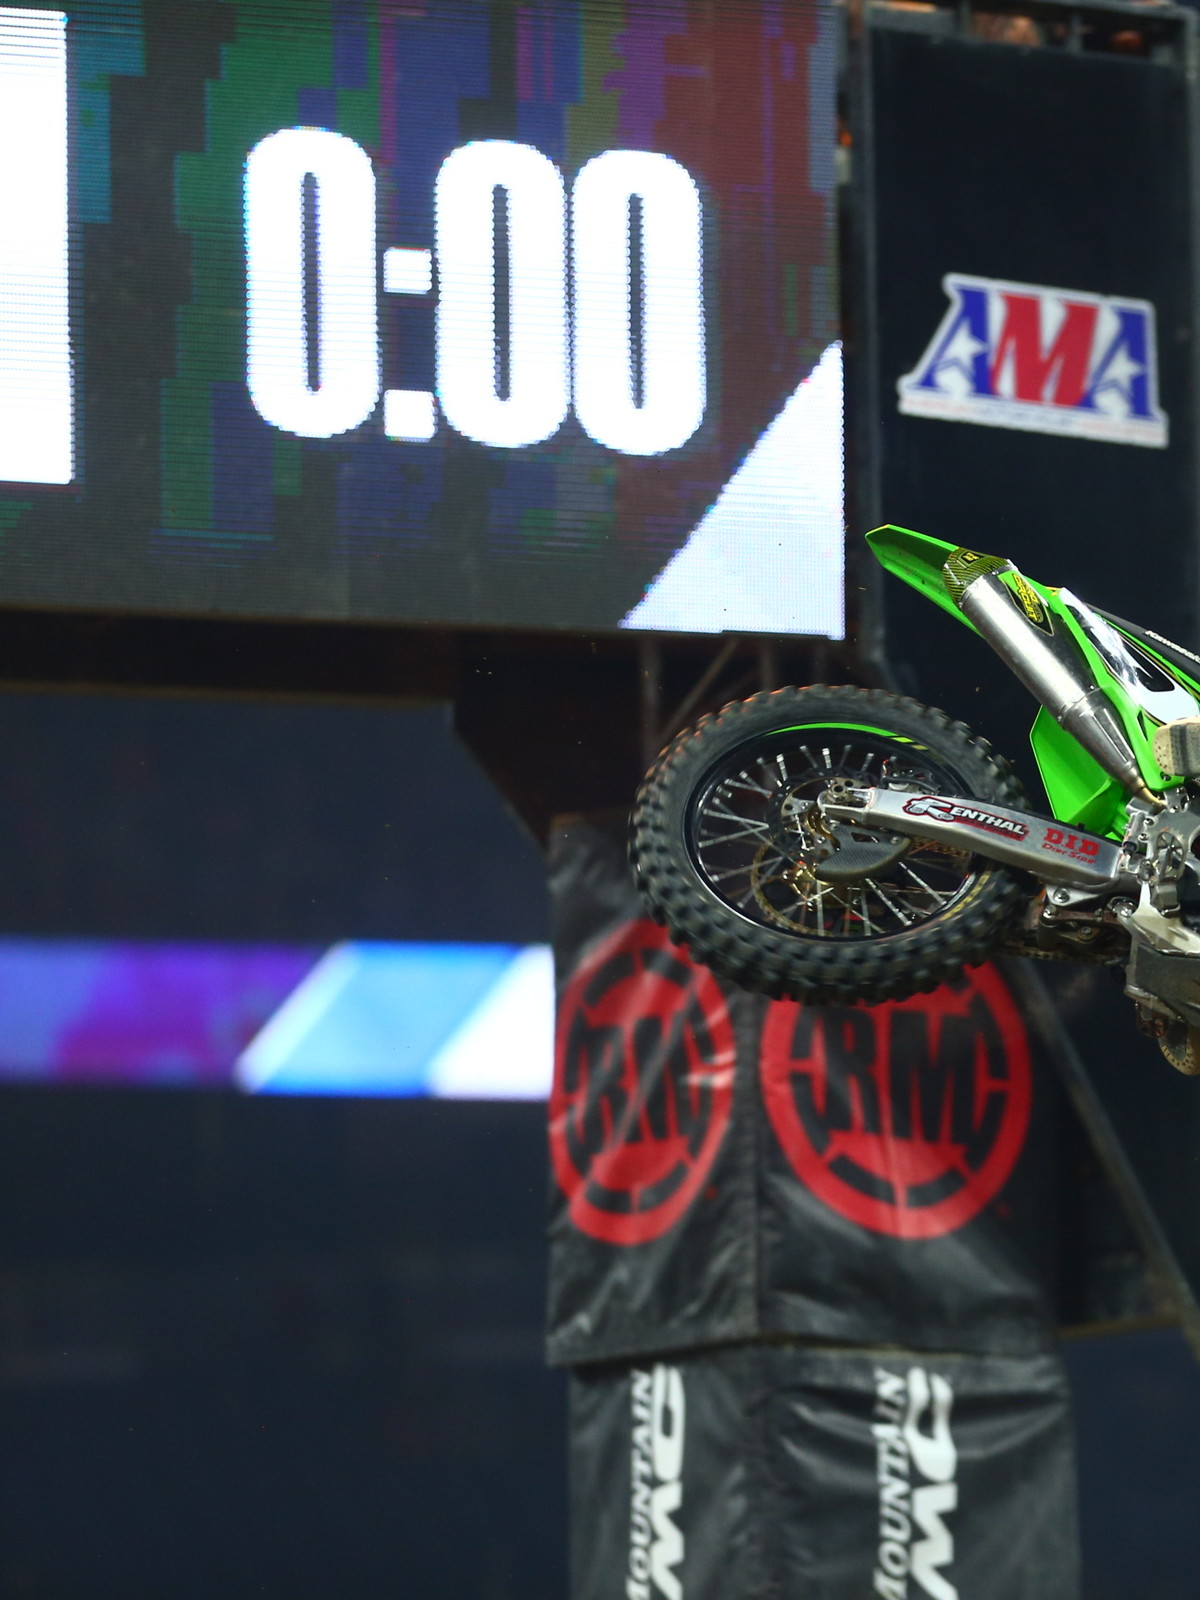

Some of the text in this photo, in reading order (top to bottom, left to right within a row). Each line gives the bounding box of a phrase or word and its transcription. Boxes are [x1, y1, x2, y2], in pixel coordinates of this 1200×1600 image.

[243, 126, 706, 457] 0:00
[910, 283, 1156, 421] AMA
[904, 797, 1026, 836] RENTHAL
